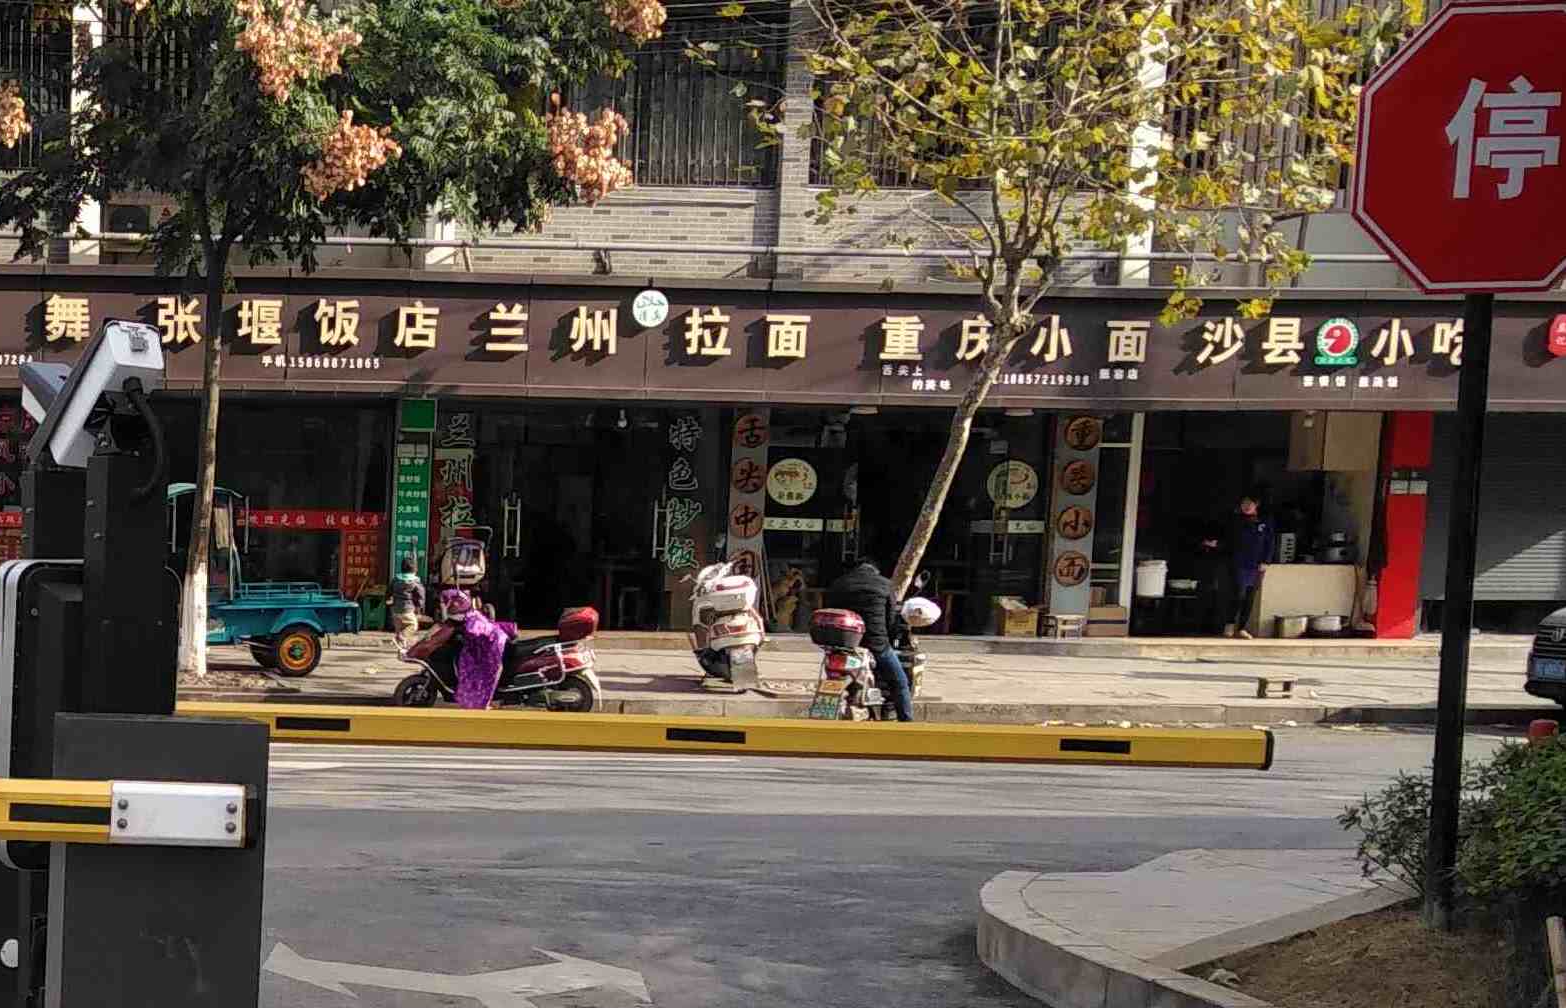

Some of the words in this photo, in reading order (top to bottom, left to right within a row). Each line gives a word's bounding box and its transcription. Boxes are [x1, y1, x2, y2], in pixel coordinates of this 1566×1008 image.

[1444, 75, 1562, 200] 停
[157, 297, 440, 348] 张堰饭店
[485, 302, 812, 358] 兰州拉面
[879, 314, 1151, 364] 重庆小面
[1196, 316, 1465, 366] 沙县小吃
